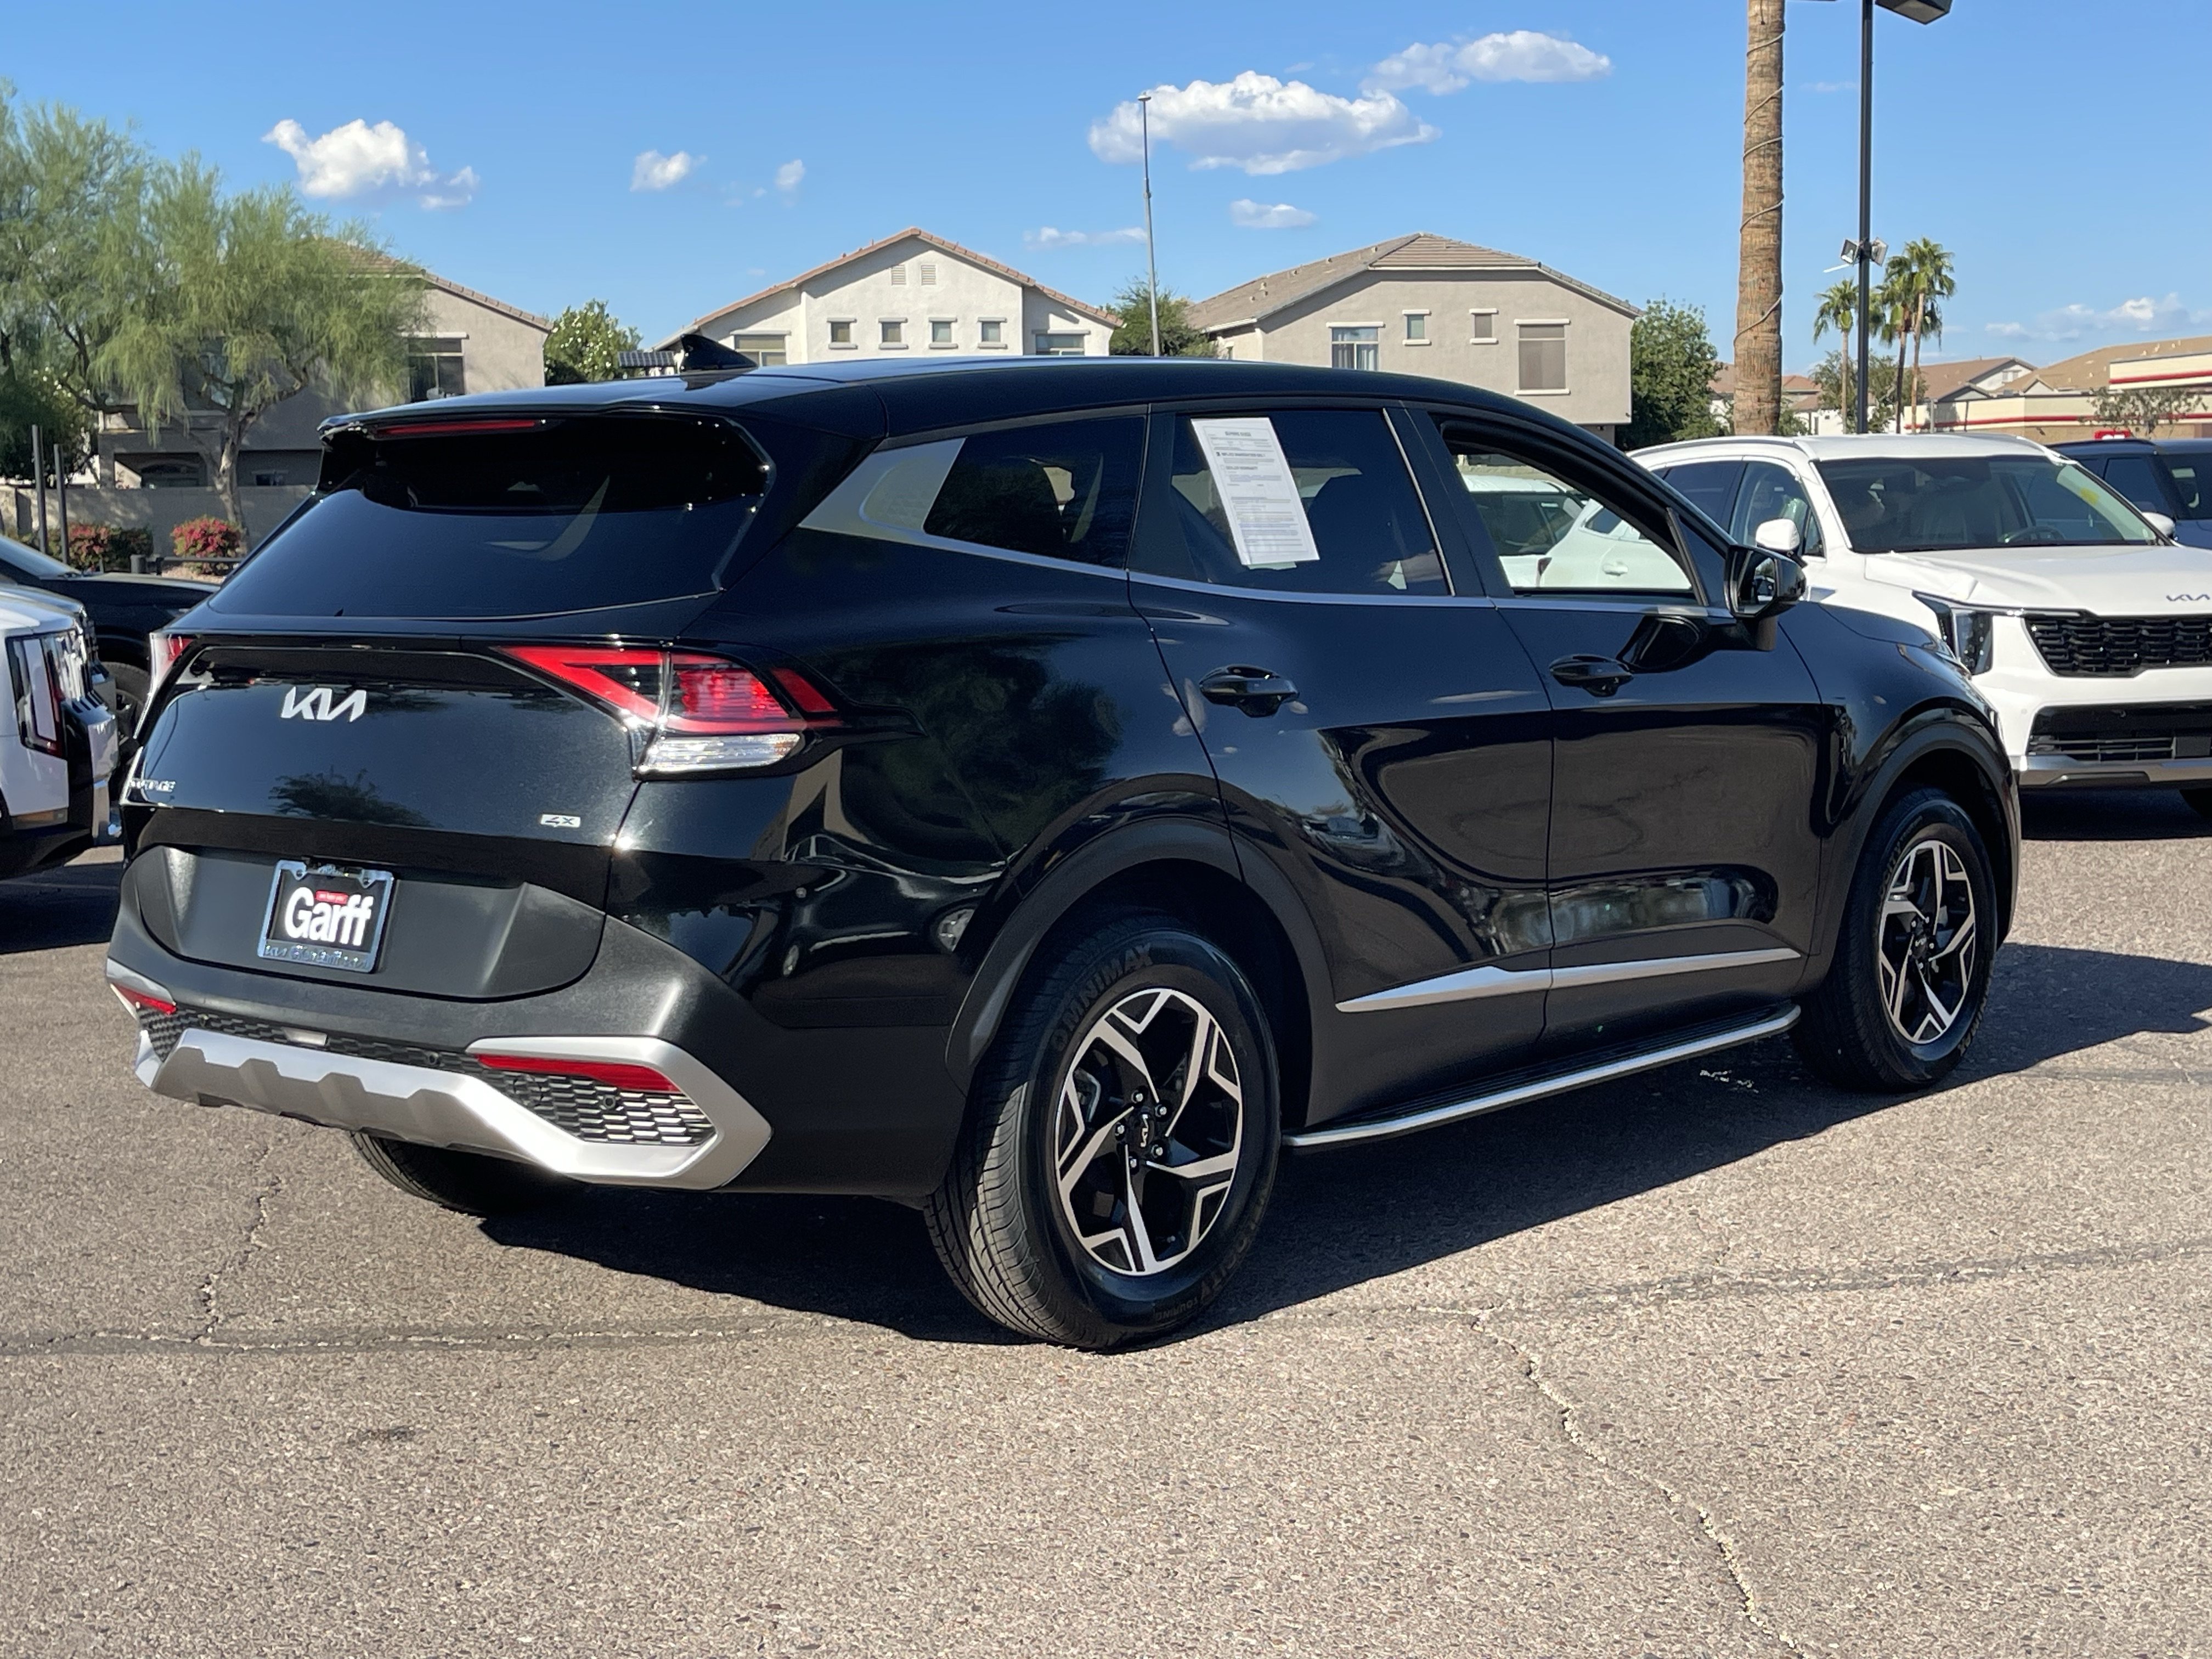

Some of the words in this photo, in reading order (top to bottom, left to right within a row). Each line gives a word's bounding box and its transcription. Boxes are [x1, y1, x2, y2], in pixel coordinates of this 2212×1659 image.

[281, 686, 367, 723] KIA
[285, 887, 373, 946] Garff
[1053, 941, 1153, 1051] OMNIMAX
